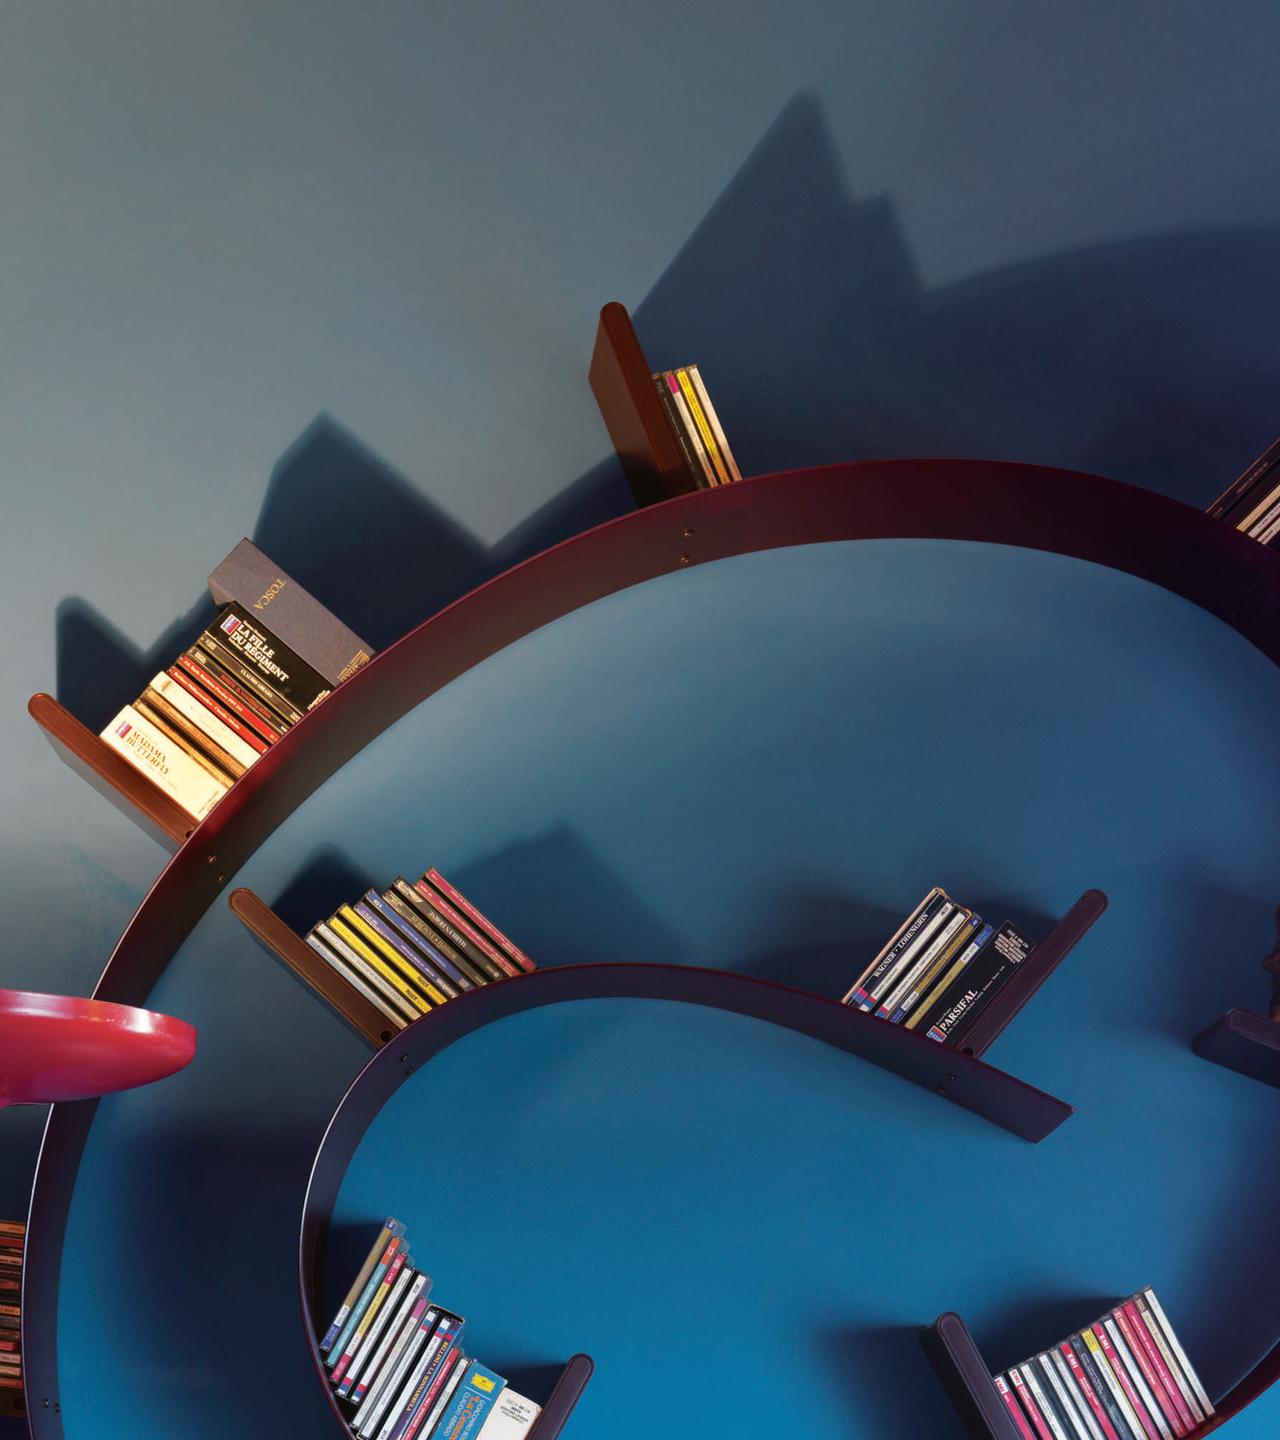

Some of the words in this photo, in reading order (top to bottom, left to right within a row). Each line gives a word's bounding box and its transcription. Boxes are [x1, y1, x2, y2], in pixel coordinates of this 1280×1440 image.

[253, 575, 286, 613] TOSCA
[230, 630, 246, 646] DU
[236, 623, 251, 638] LA
[247, 633, 275, 658] FILLE
[131, 729, 168, 764] MADAMA
[872, 950, 896, 978] WAGNER
[896, 911, 929, 948] LOHENGRIN
[938, 986, 978, 1032] PARSIFAL
[1098, 1334, 1110, 1350] EMI
[1066, 1352, 1078, 1369] EMI
